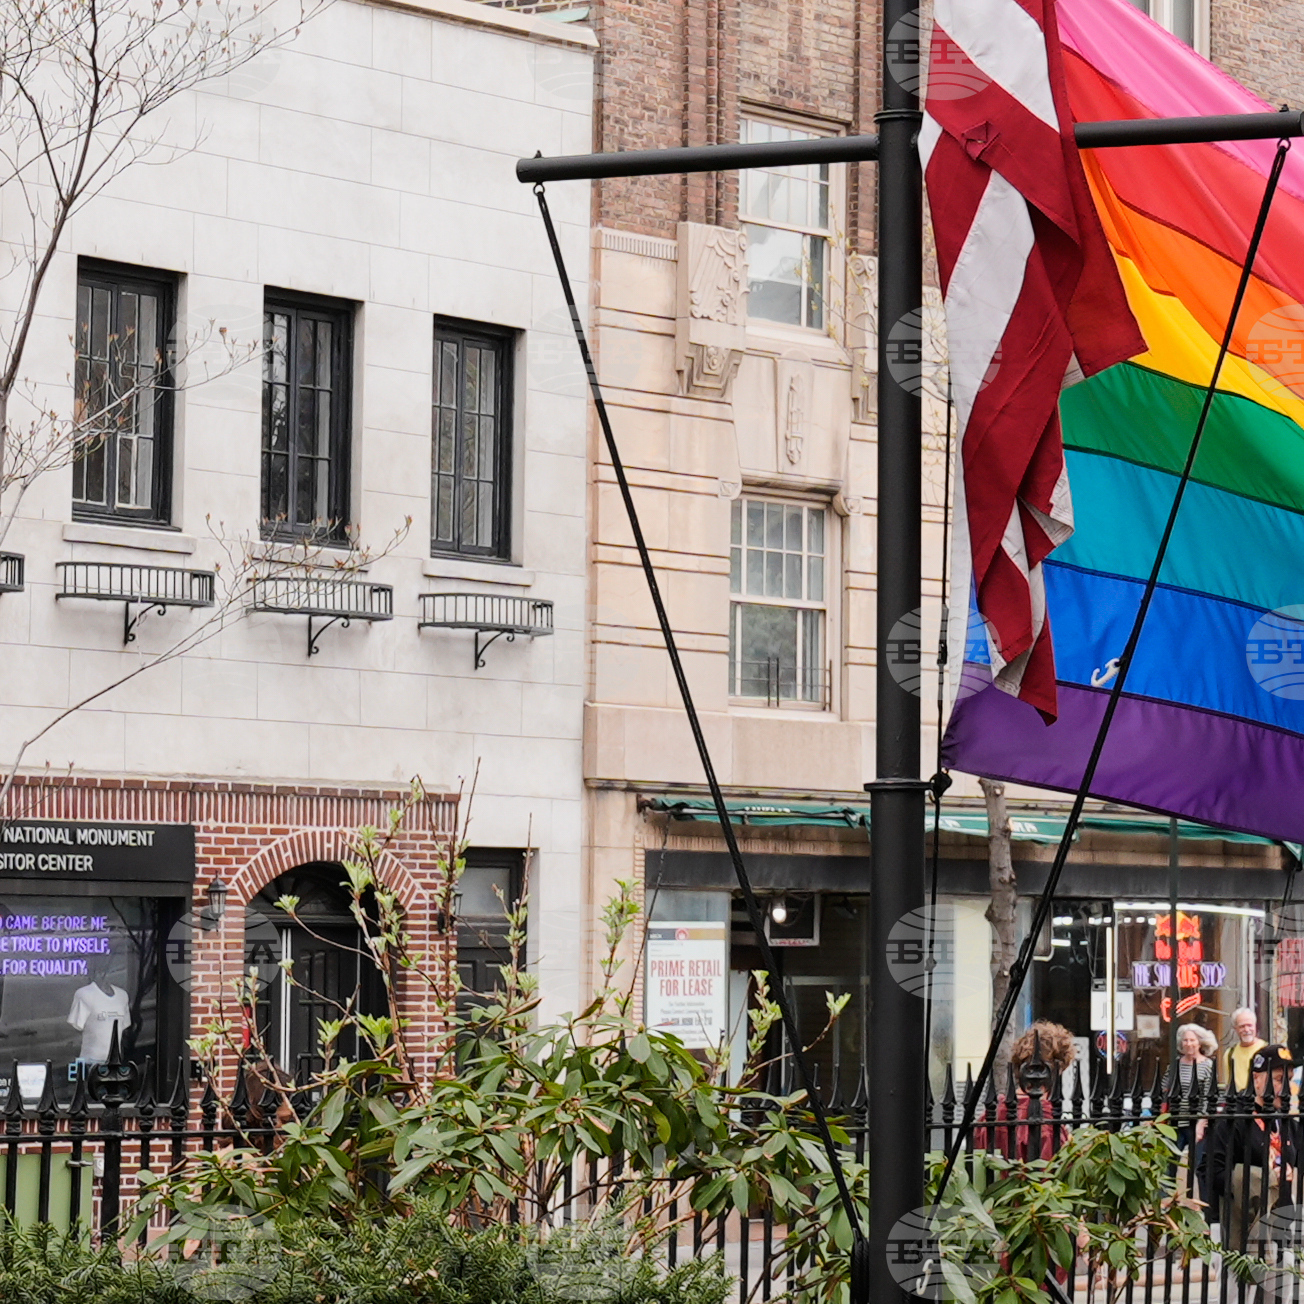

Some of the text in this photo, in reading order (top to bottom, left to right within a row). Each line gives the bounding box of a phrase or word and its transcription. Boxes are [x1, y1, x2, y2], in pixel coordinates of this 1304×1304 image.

[4, 826, 156, 847] NATIONAL MONUMENT
[38, 854, 94, 872] CENTER
[5, 915, 38, 930] CAME
[42, 916, 88, 931] BEFORE
[11, 936, 43, 952] TRUE
[47, 937, 60, 952] TO
[3, 958, 27, 975] FOR
[650, 959, 722, 977] PRIME RETAIL
[660, 978, 713, 997] FOR LEASE
